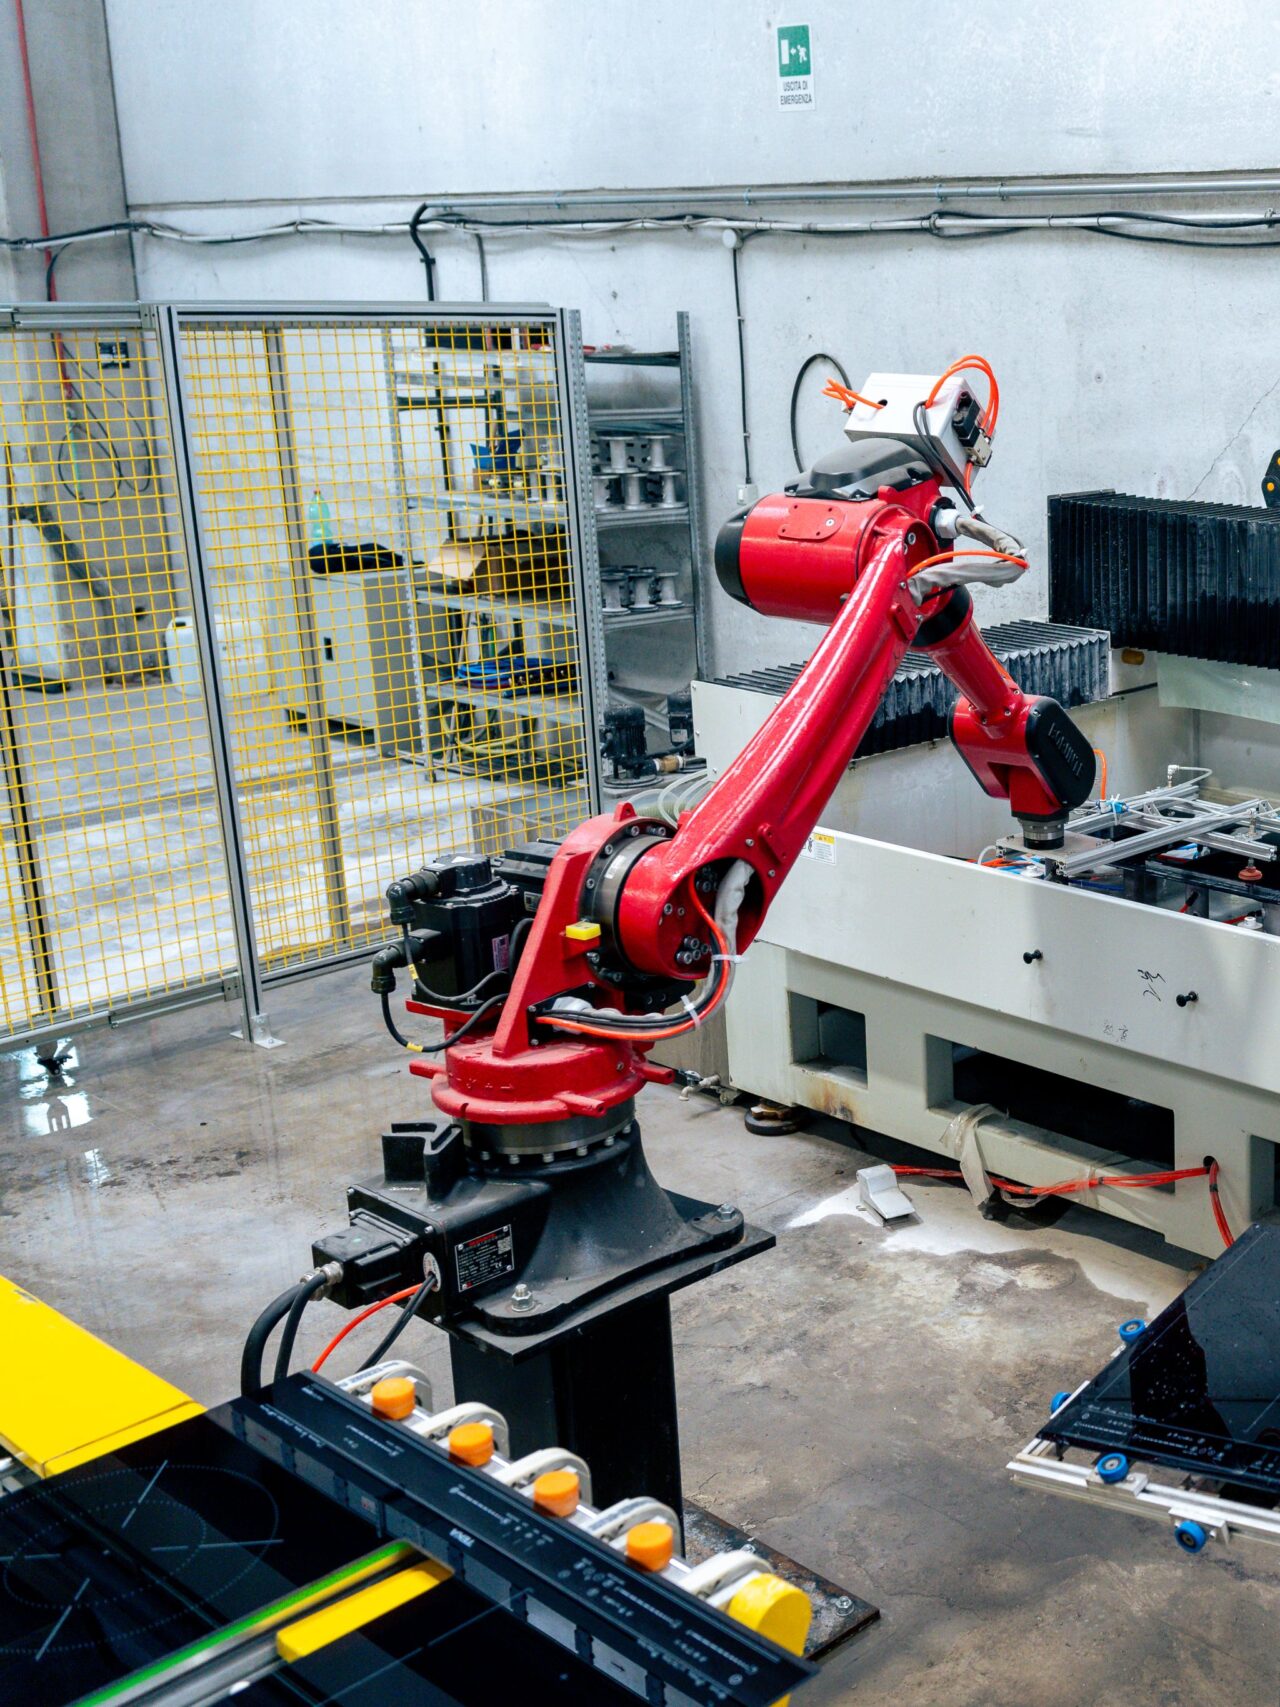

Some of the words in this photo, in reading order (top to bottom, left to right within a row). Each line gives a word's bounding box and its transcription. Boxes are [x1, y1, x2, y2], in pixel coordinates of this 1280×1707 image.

[783, 80, 801, 92] USCITA
[802, 80, 808, 90] DI
[780, 93, 812, 105] EMERGENZA
